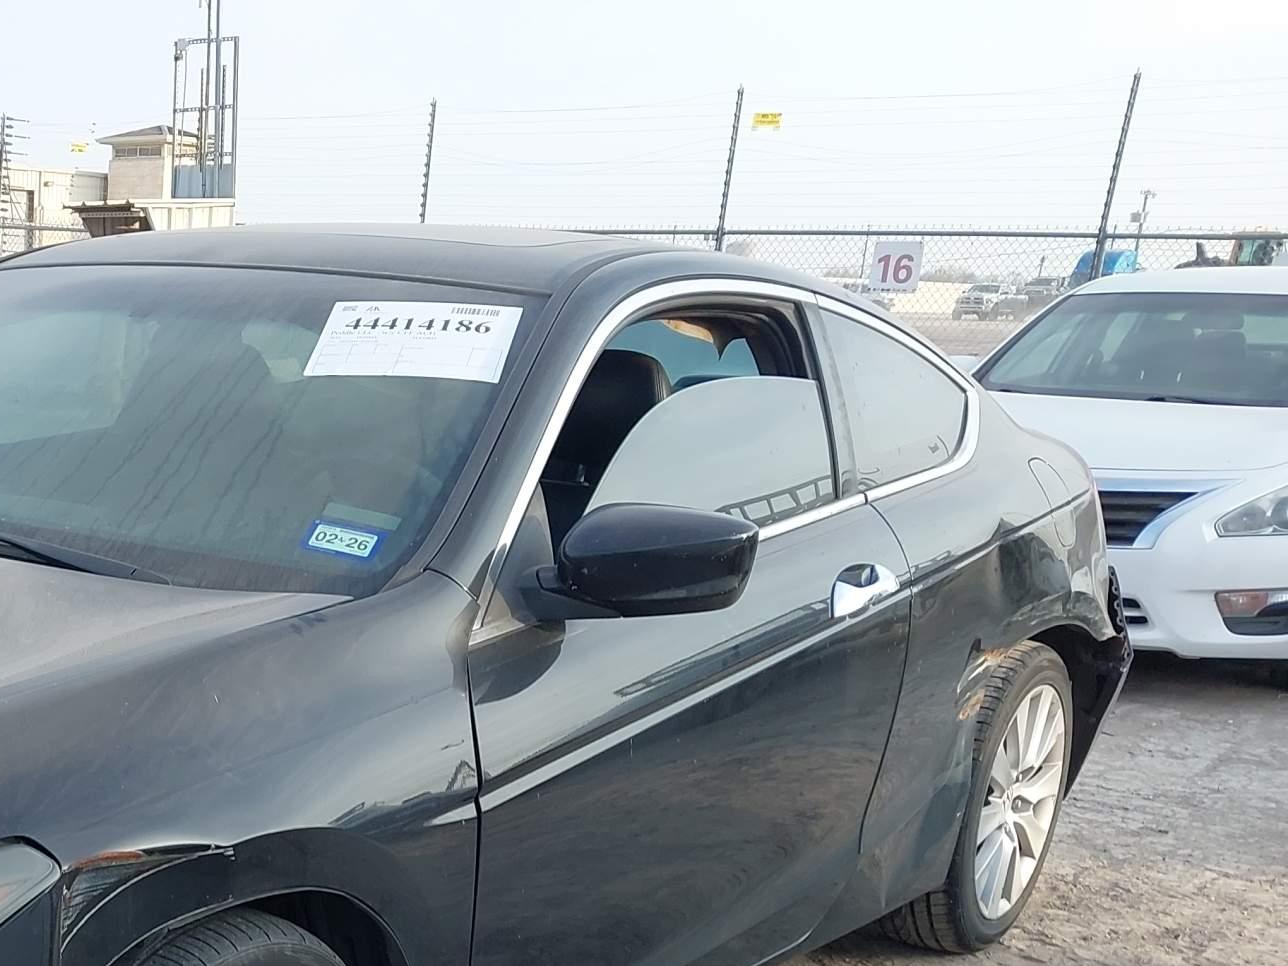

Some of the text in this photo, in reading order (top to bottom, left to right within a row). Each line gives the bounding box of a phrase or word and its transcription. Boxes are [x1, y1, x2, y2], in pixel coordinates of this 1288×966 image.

[877, 254, 915, 285] 16
[344, 316, 492, 334] 44414186
[314, 531, 339, 544] 02
[344, 537, 370, 551] 26
